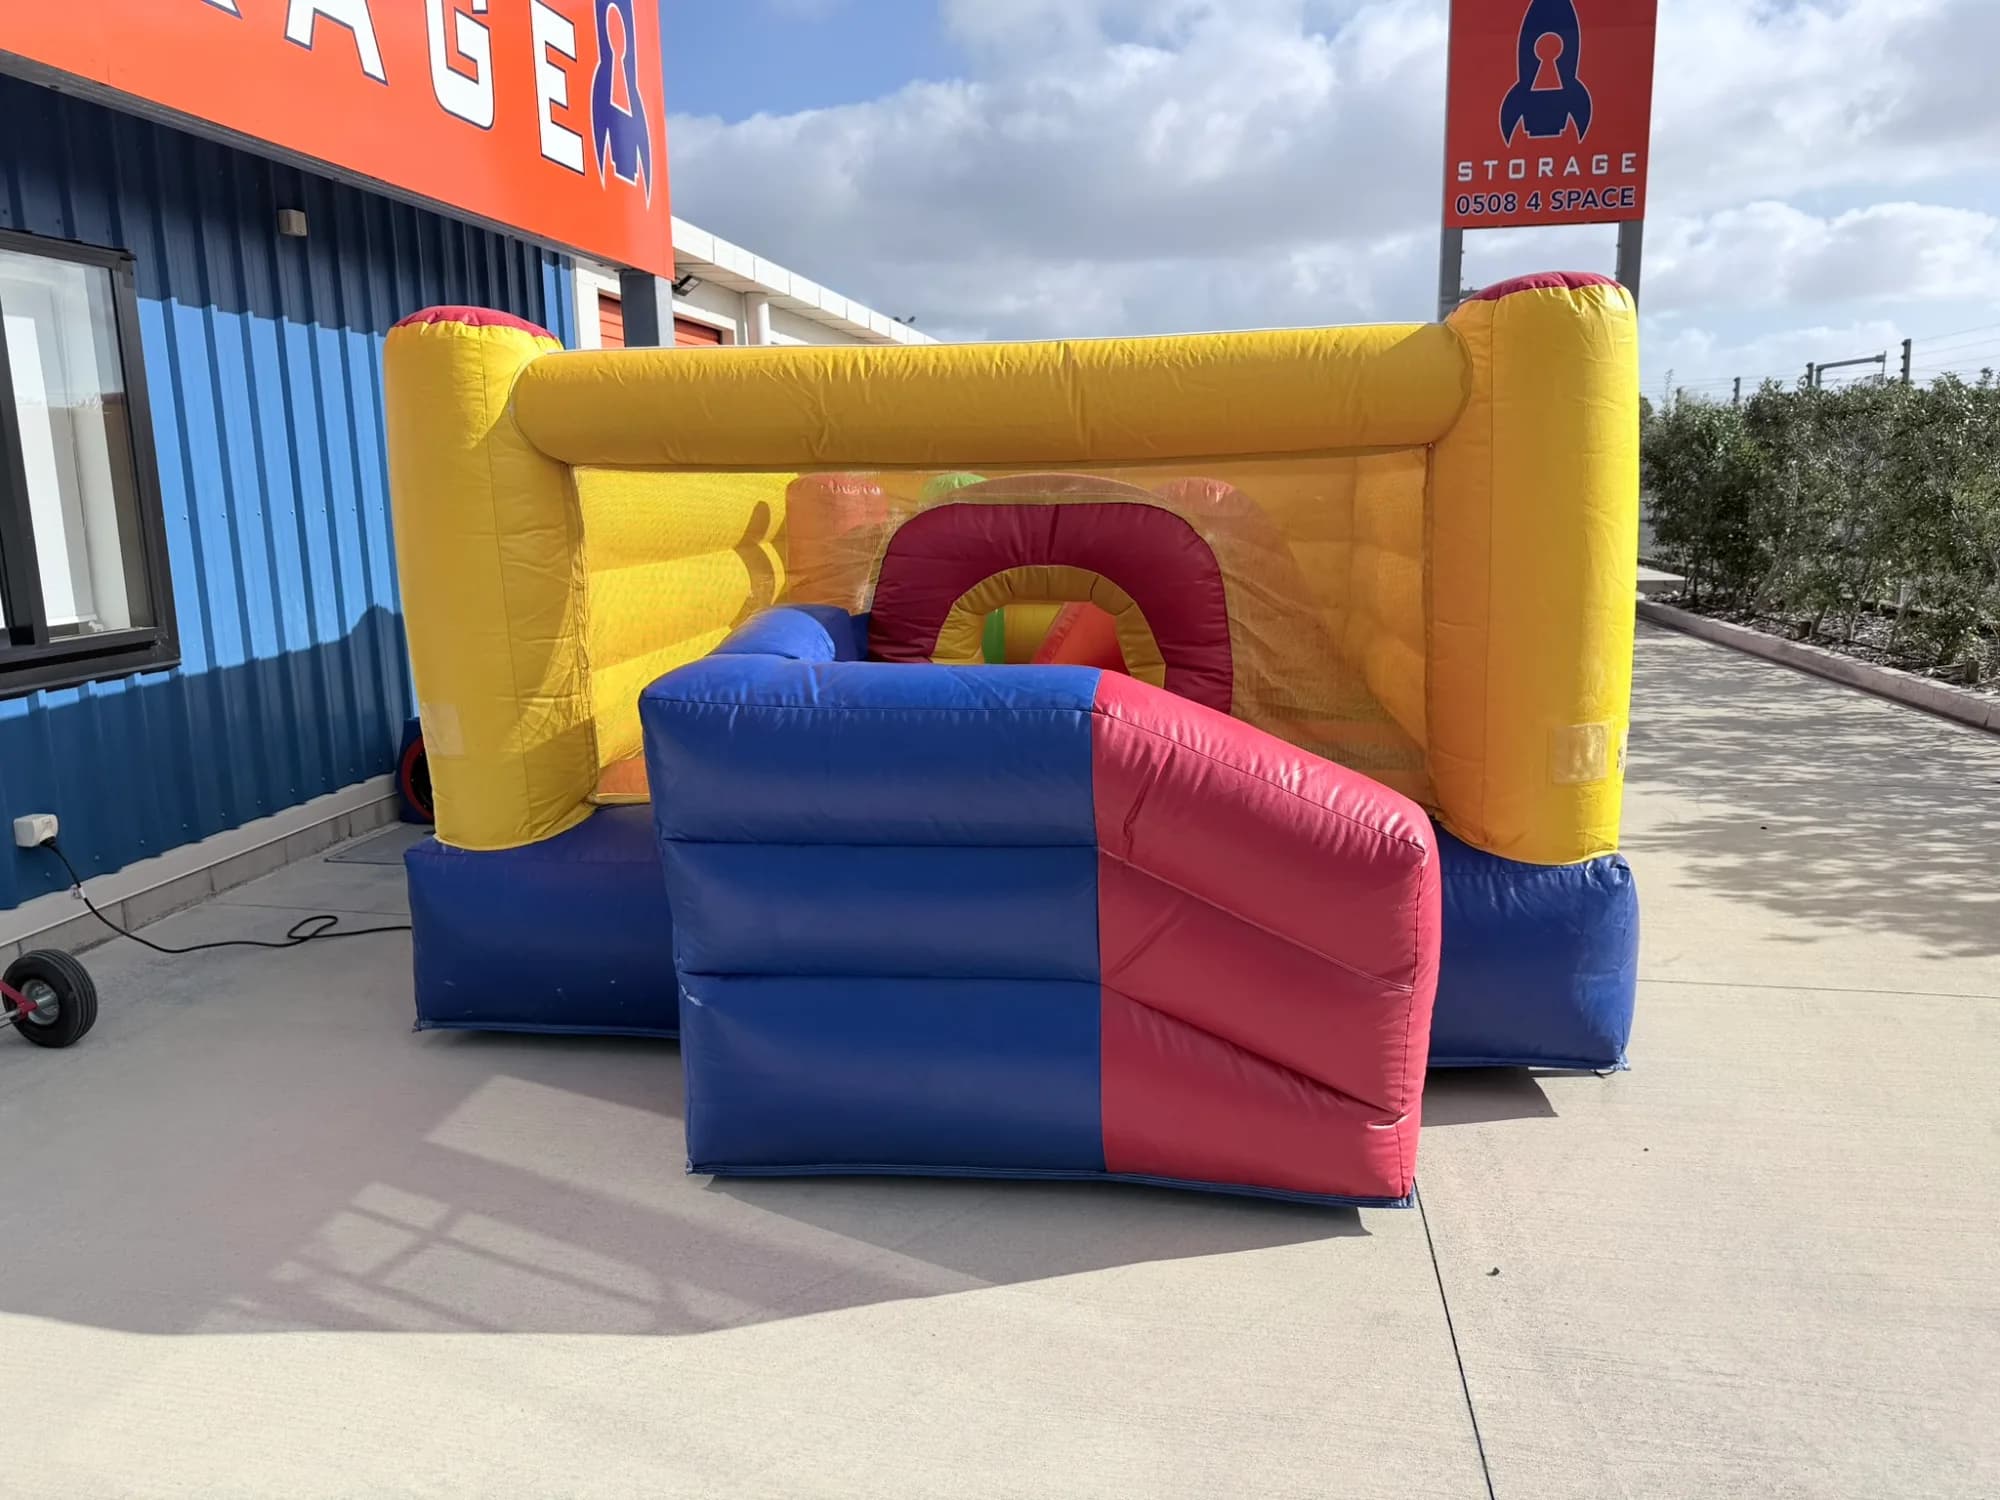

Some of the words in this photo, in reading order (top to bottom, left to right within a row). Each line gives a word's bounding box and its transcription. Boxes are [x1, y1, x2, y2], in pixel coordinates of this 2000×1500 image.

[1457, 152, 1636, 182] STORAGE
[1456, 193, 1517, 215] 0508
[1526, 191, 1541, 212] 4
[1550, 186, 1635, 211] SPACE
